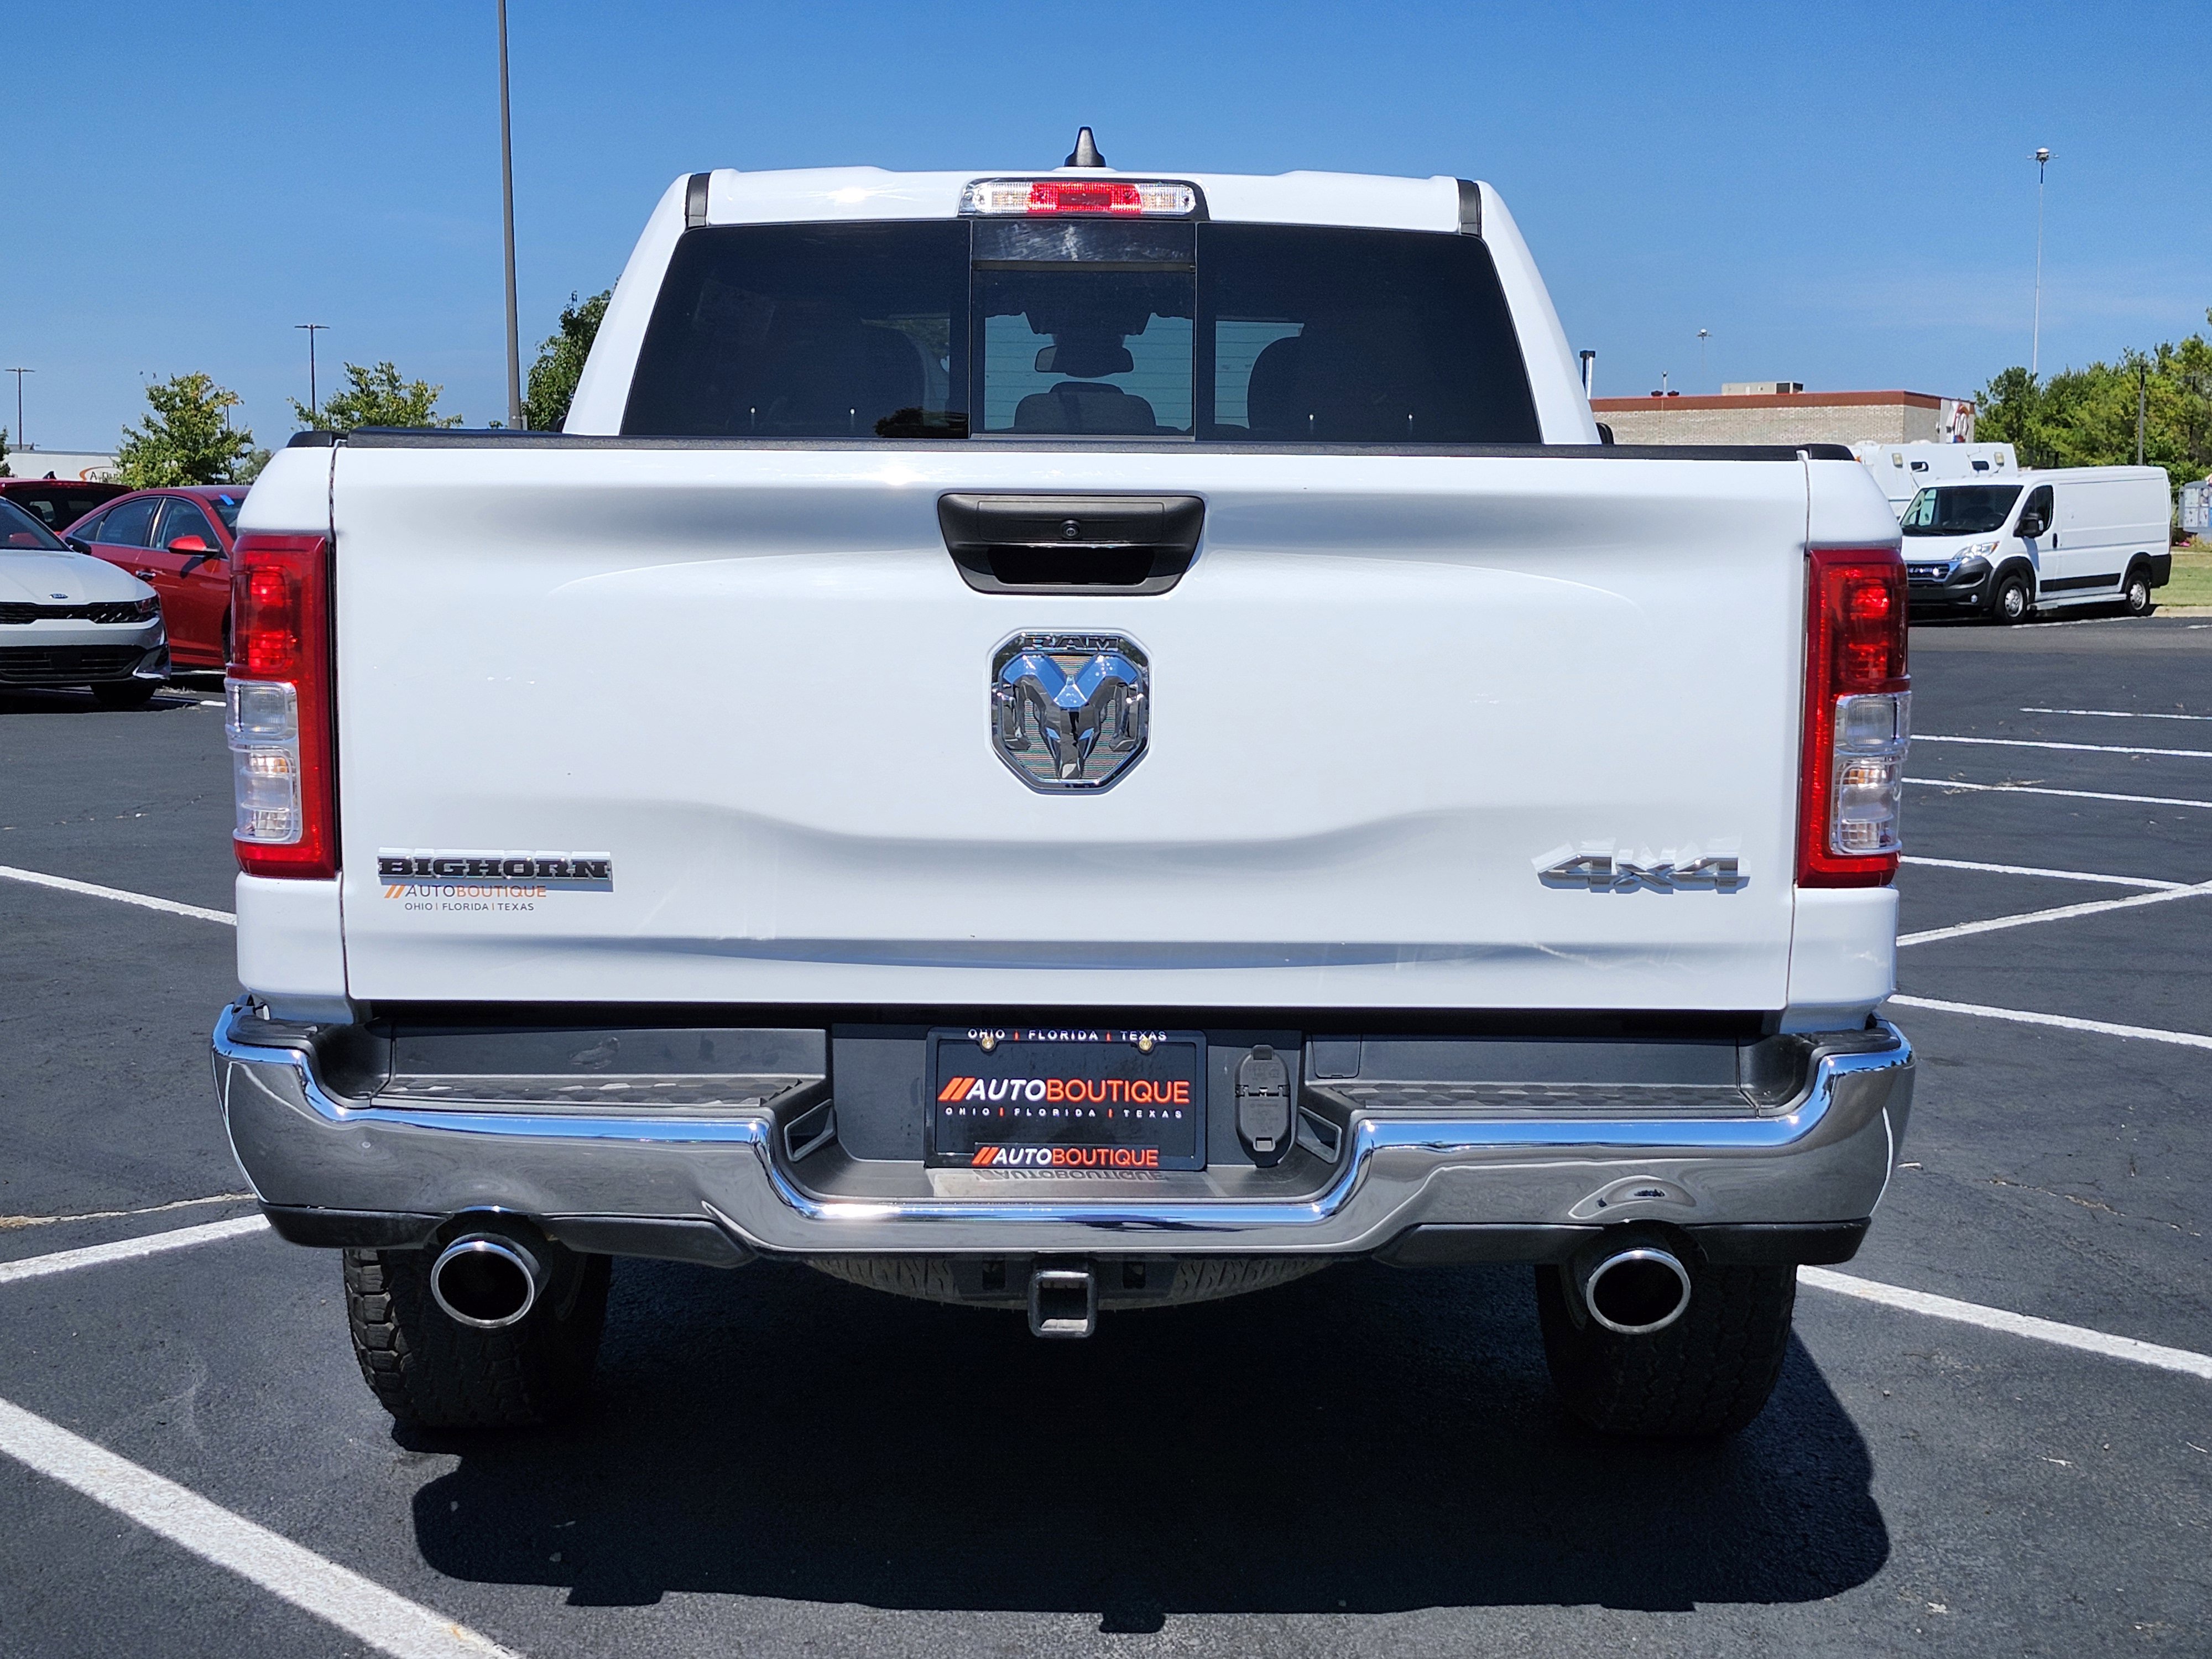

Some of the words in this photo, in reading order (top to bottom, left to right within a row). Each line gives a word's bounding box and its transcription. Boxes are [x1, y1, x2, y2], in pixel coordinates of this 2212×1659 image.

[1022, 637, 1118, 650] RAM
[378, 853, 610, 880] BIGHORN
[405, 885, 546, 898] AUTOBOUTIQUE
[405, 902, 433, 911] OHIO
[968, 1029, 1005, 1039] OHIO
[1028, 1030, 1099, 1041] FLORIDA
[1120, 1030, 1167, 1041] TEXAS
[966, 1078, 1190, 1103] AUTOBOUTIQUE
[945, 1107, 990, 1116] OHIO
[1014, 1108, 1096, 1117] FLORIDA
[1124, 1109, 1182, 1118] TEXAS
[993, 1147, 1159, 1167] AUTOBOUTIQUE
